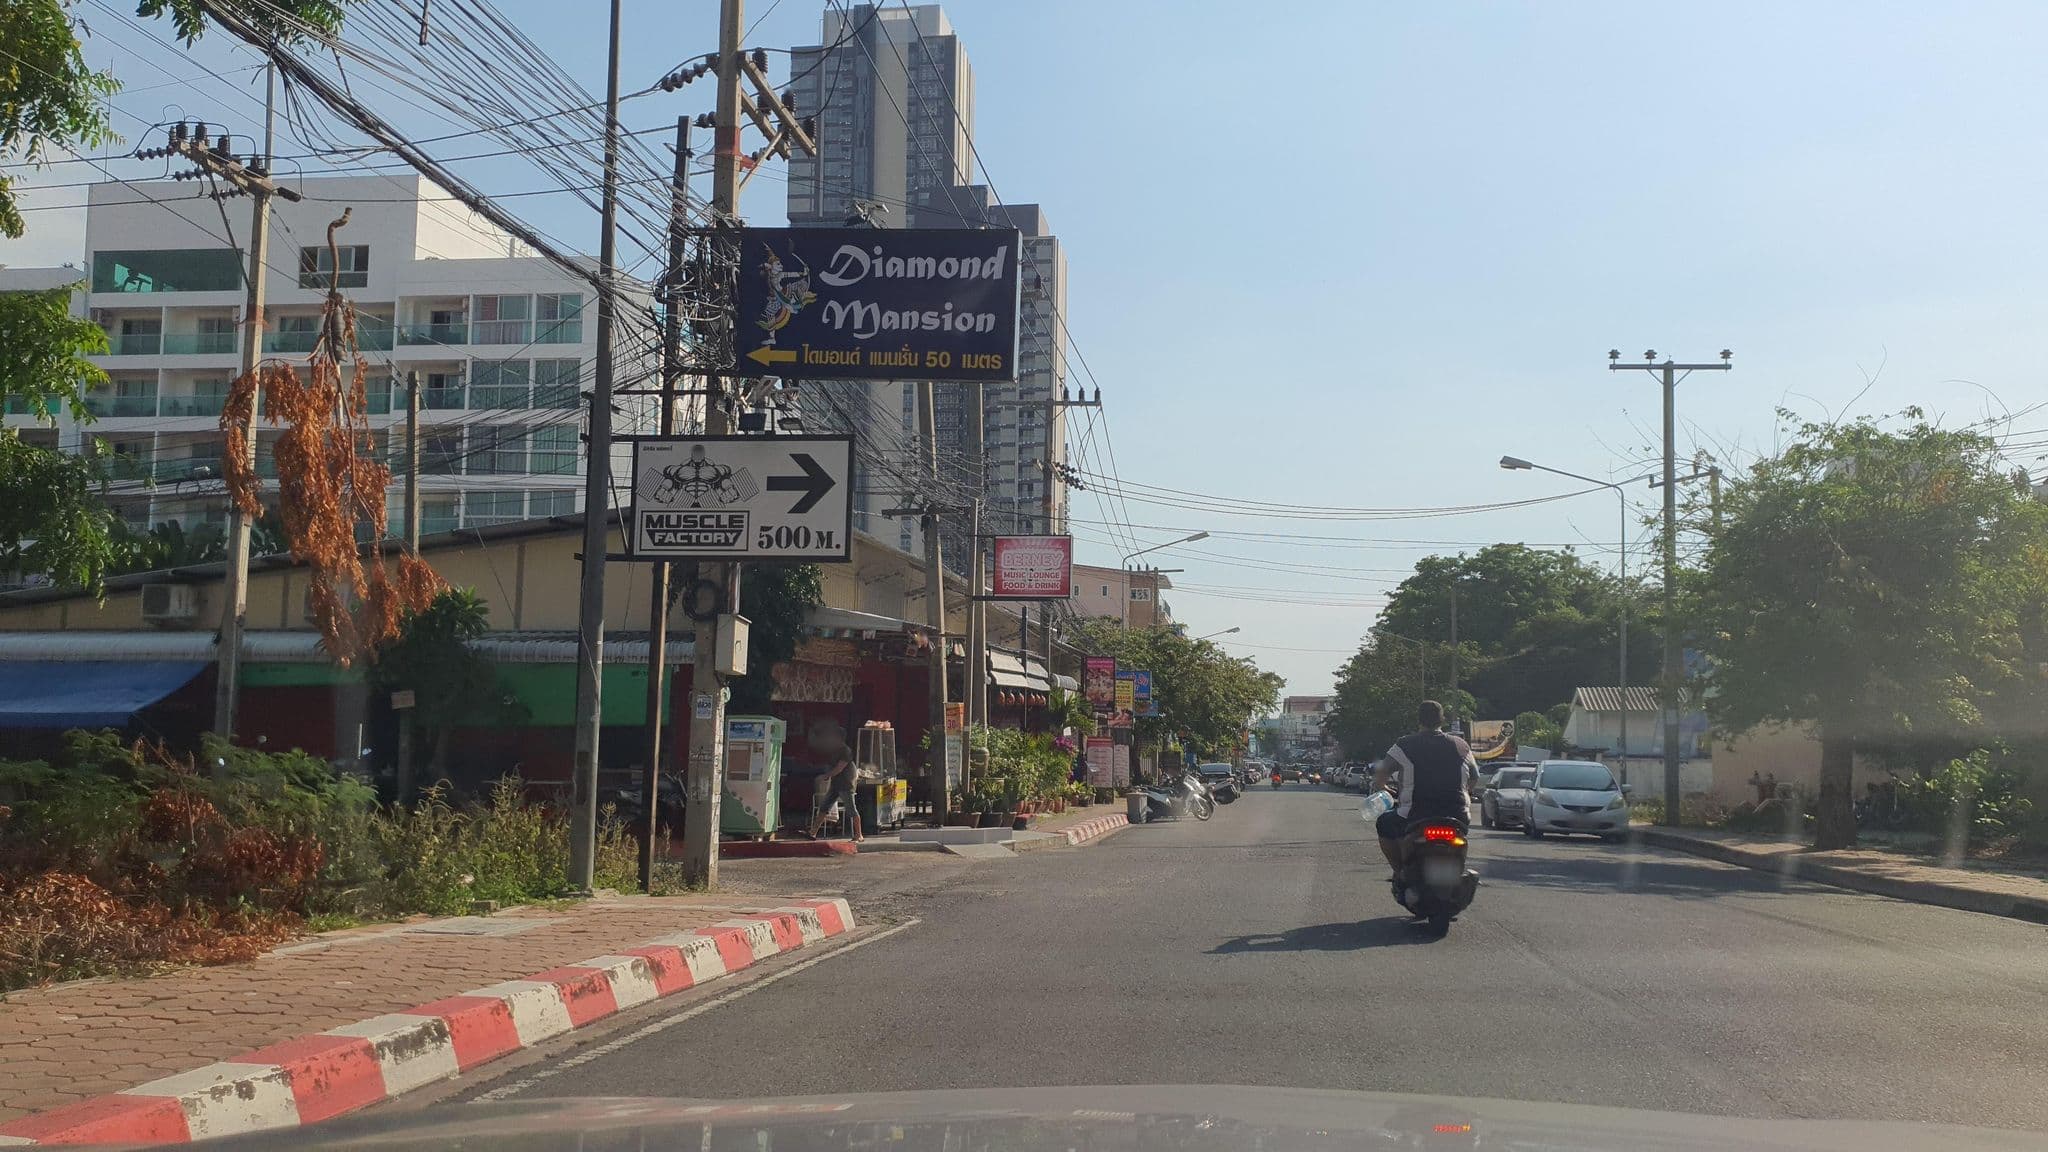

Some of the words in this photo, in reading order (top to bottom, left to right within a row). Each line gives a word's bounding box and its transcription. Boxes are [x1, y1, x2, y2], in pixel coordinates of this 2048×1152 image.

[819, 244, 1008, 287] Diamond
[822, 300, 996, 340] Mansion
[802, 343, 861, 365] ไดมอนด์
[869, 343, 918, 367] แมนชั่น
[925, 351, 951, 368] 50
[961, 353, 1002, 370] เมตร
[645, 514, 745, 529] MUSCLE
[654, 532, 738, 544] FACTORY
[757, 525, 811, 550] 500
[1003, 571, 1026, 579] MUSIC
[1029, 571, 1060, 579] LOUNGE
